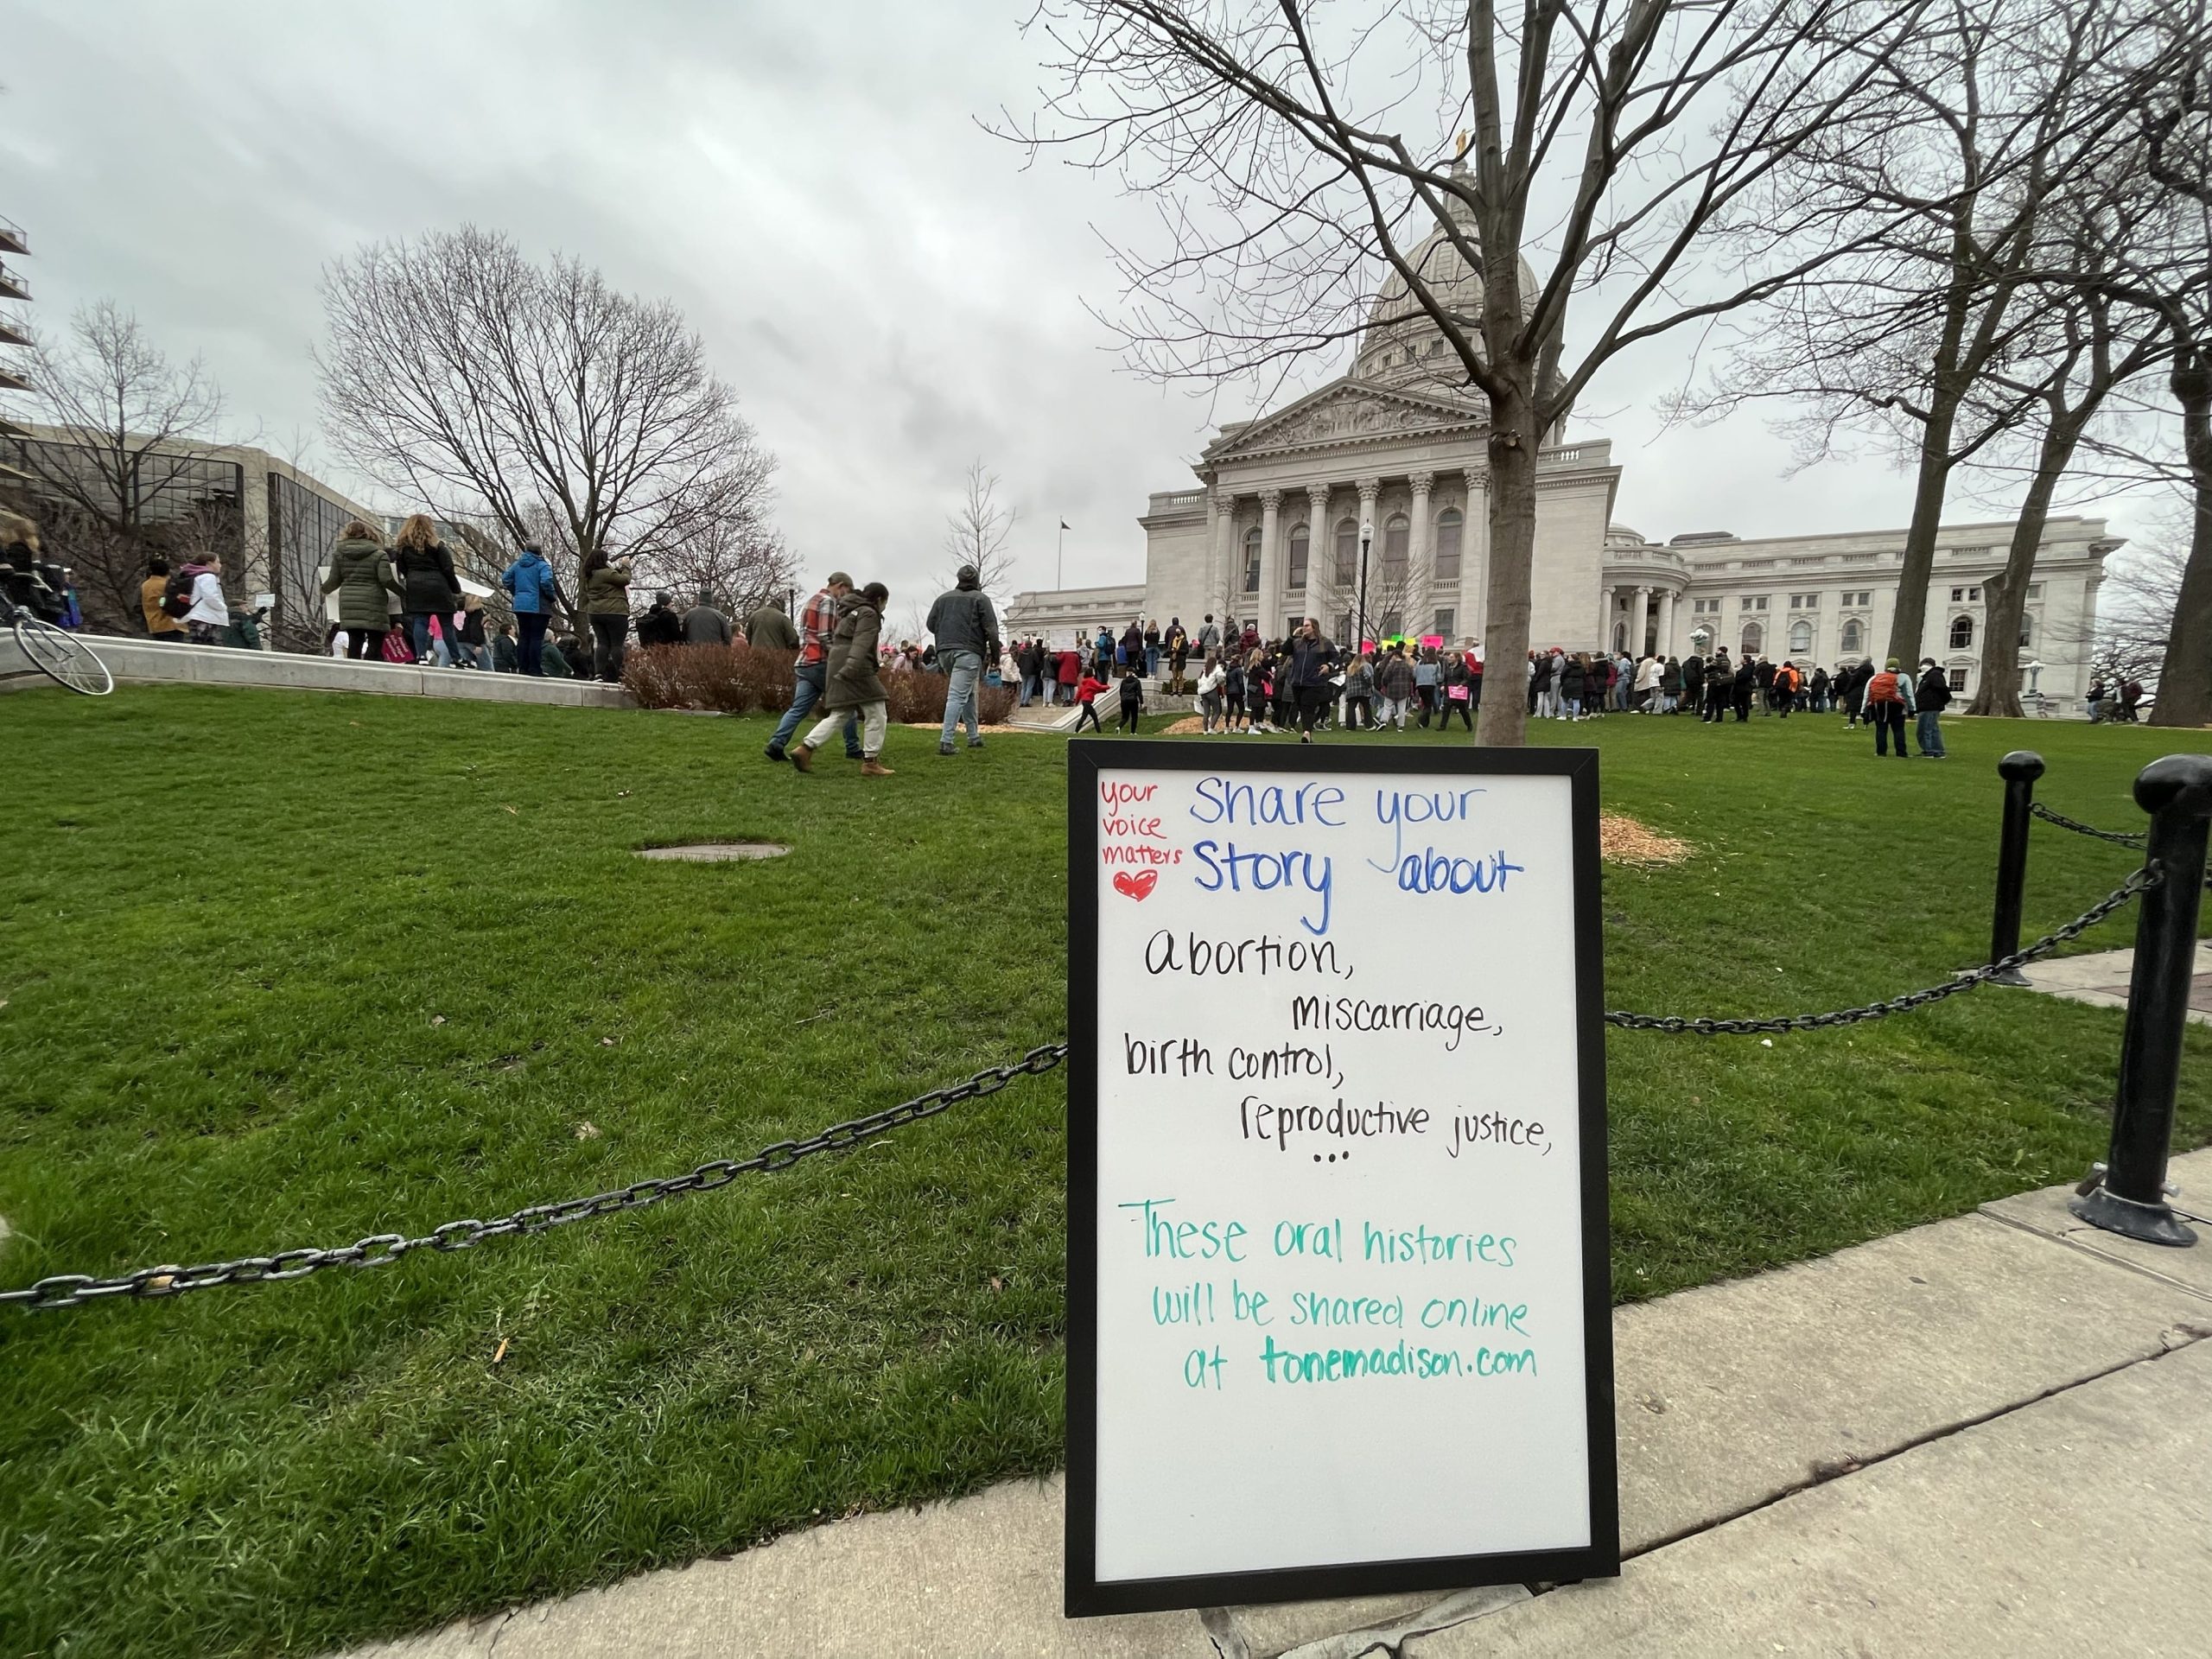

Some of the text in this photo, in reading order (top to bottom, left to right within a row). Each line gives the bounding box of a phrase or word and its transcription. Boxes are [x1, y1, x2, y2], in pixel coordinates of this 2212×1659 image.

[1103, 814, 1167, 839] voice
[1103, 844, 1183, 865] matters
[1190, 777, 1488, 874] Share your
[1192, 840, 1525, 935] Story about
[1123, 1033, 1345, 1090] birth control,
[1240, 1095, 1554, 1160] reproductive justice,
[1117, 1198, 1518, 1268] These oral histories
[1152, 1278, 1531, 1338] will be shared online
[1184, 1335, 1538, 1391] at tonemadison.com
